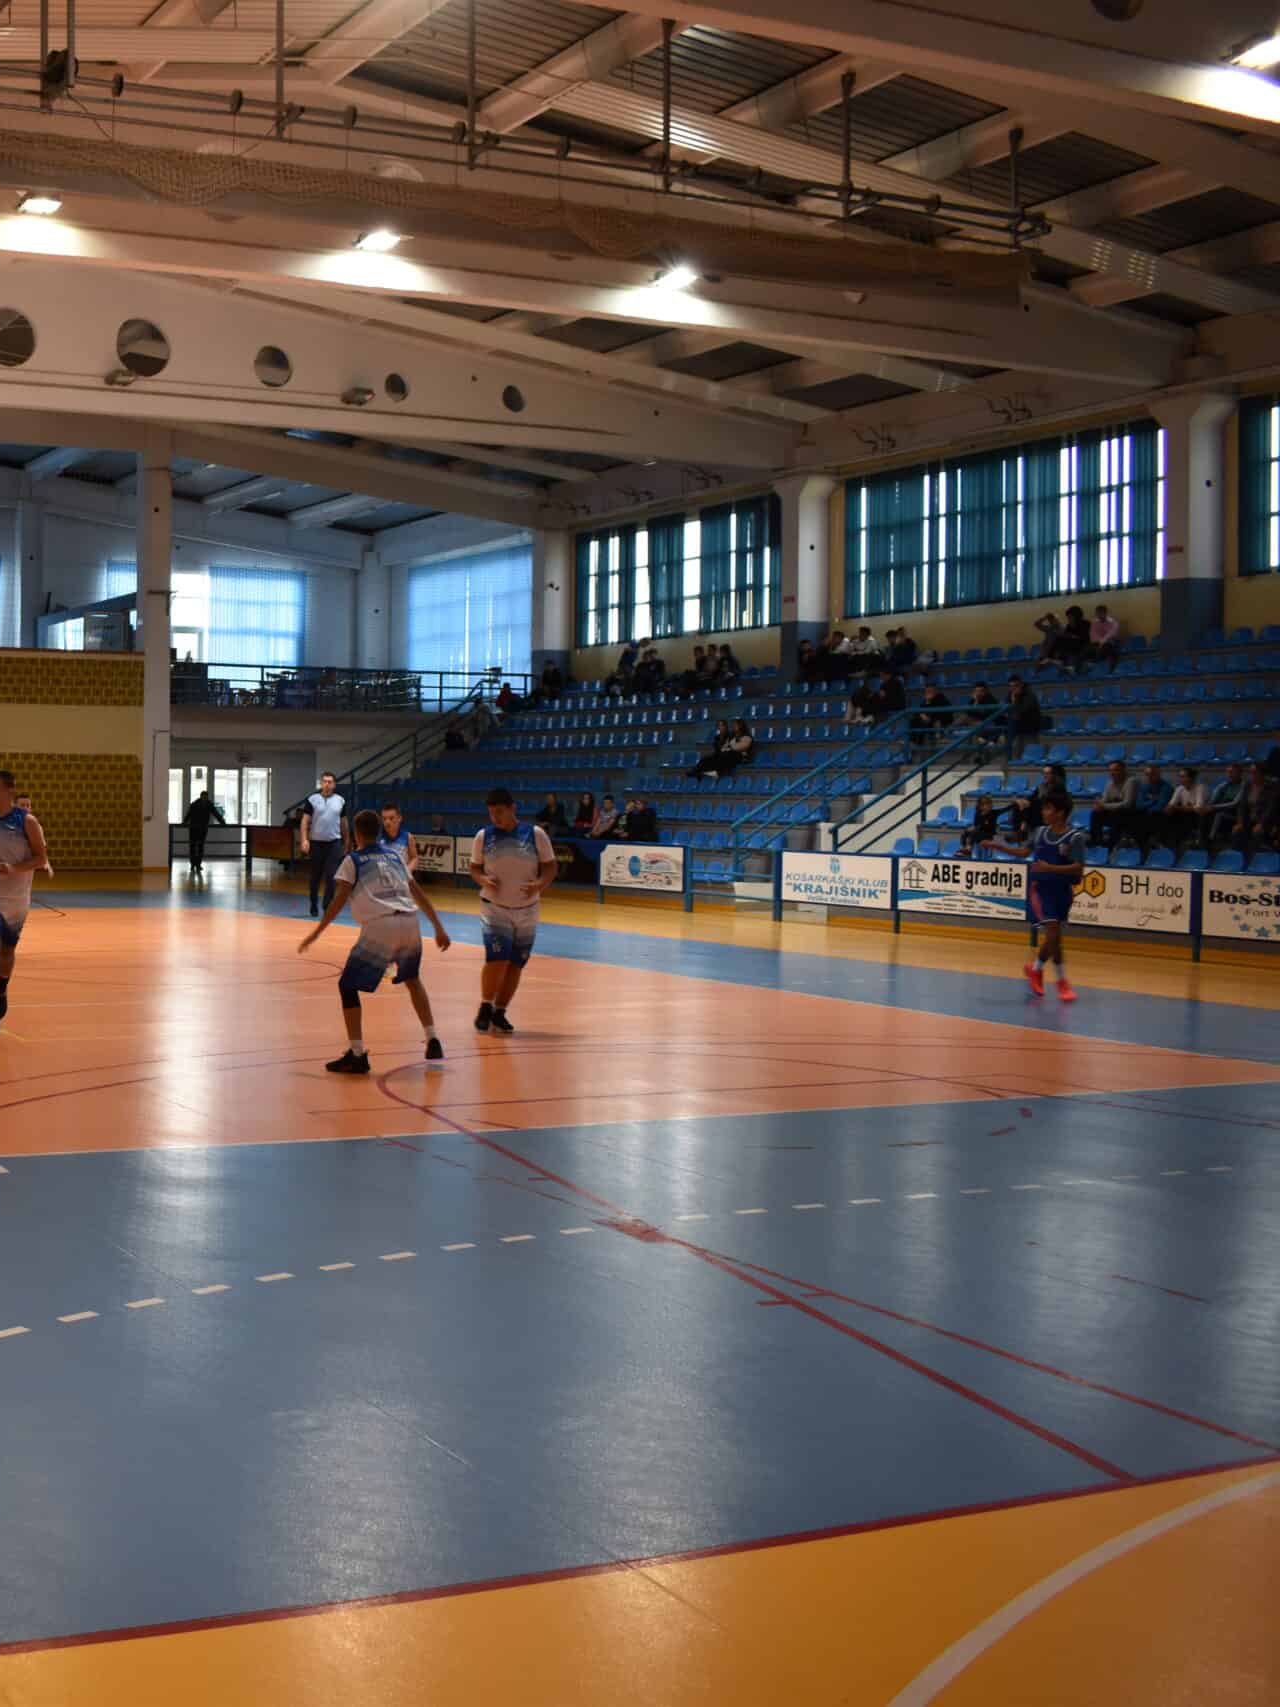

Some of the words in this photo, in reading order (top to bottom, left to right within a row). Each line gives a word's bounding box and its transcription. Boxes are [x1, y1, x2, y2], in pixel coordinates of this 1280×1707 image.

[930, 863, 961, 884] ABE
[965, 866, 1023, 892] gradnja
[1120, 874, 1150, 896] BH
[1156, 882, 1184, 898] doo
